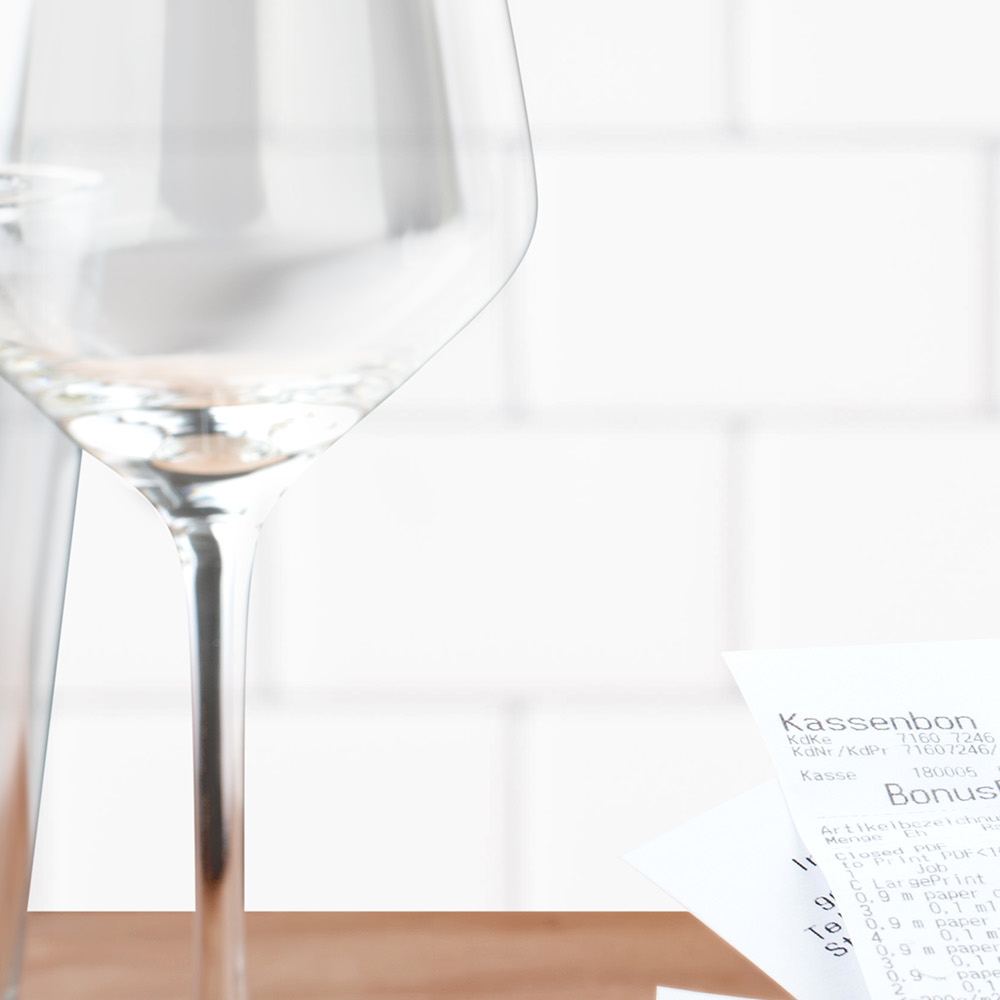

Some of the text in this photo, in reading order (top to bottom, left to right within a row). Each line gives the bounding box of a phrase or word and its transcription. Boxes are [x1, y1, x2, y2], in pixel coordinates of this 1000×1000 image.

[778, 711, 978, 732] Kassenbon
[787, 732, 995, 745] KdKe 7160 7246
[791, 745, 887, 757] KdNr/KdPr
[800, 769, 857, 781] Kasse
[912, 766, 978, 779] 180005
[834, 842, 947, 861] Closed PDF
[842, 860, 864, 869] to
[874, 855, 934, 867] Print
[872, 872, 987, 891] LargePrint
[924, 889, 977, 903] paper
[860, 904, 873, 917] 3
[935, 916, 989, 930] paper
[871, 931, 883, 943] 4
[883, 956, 895, 970] 3
[892, 983, 904, 996] 2
